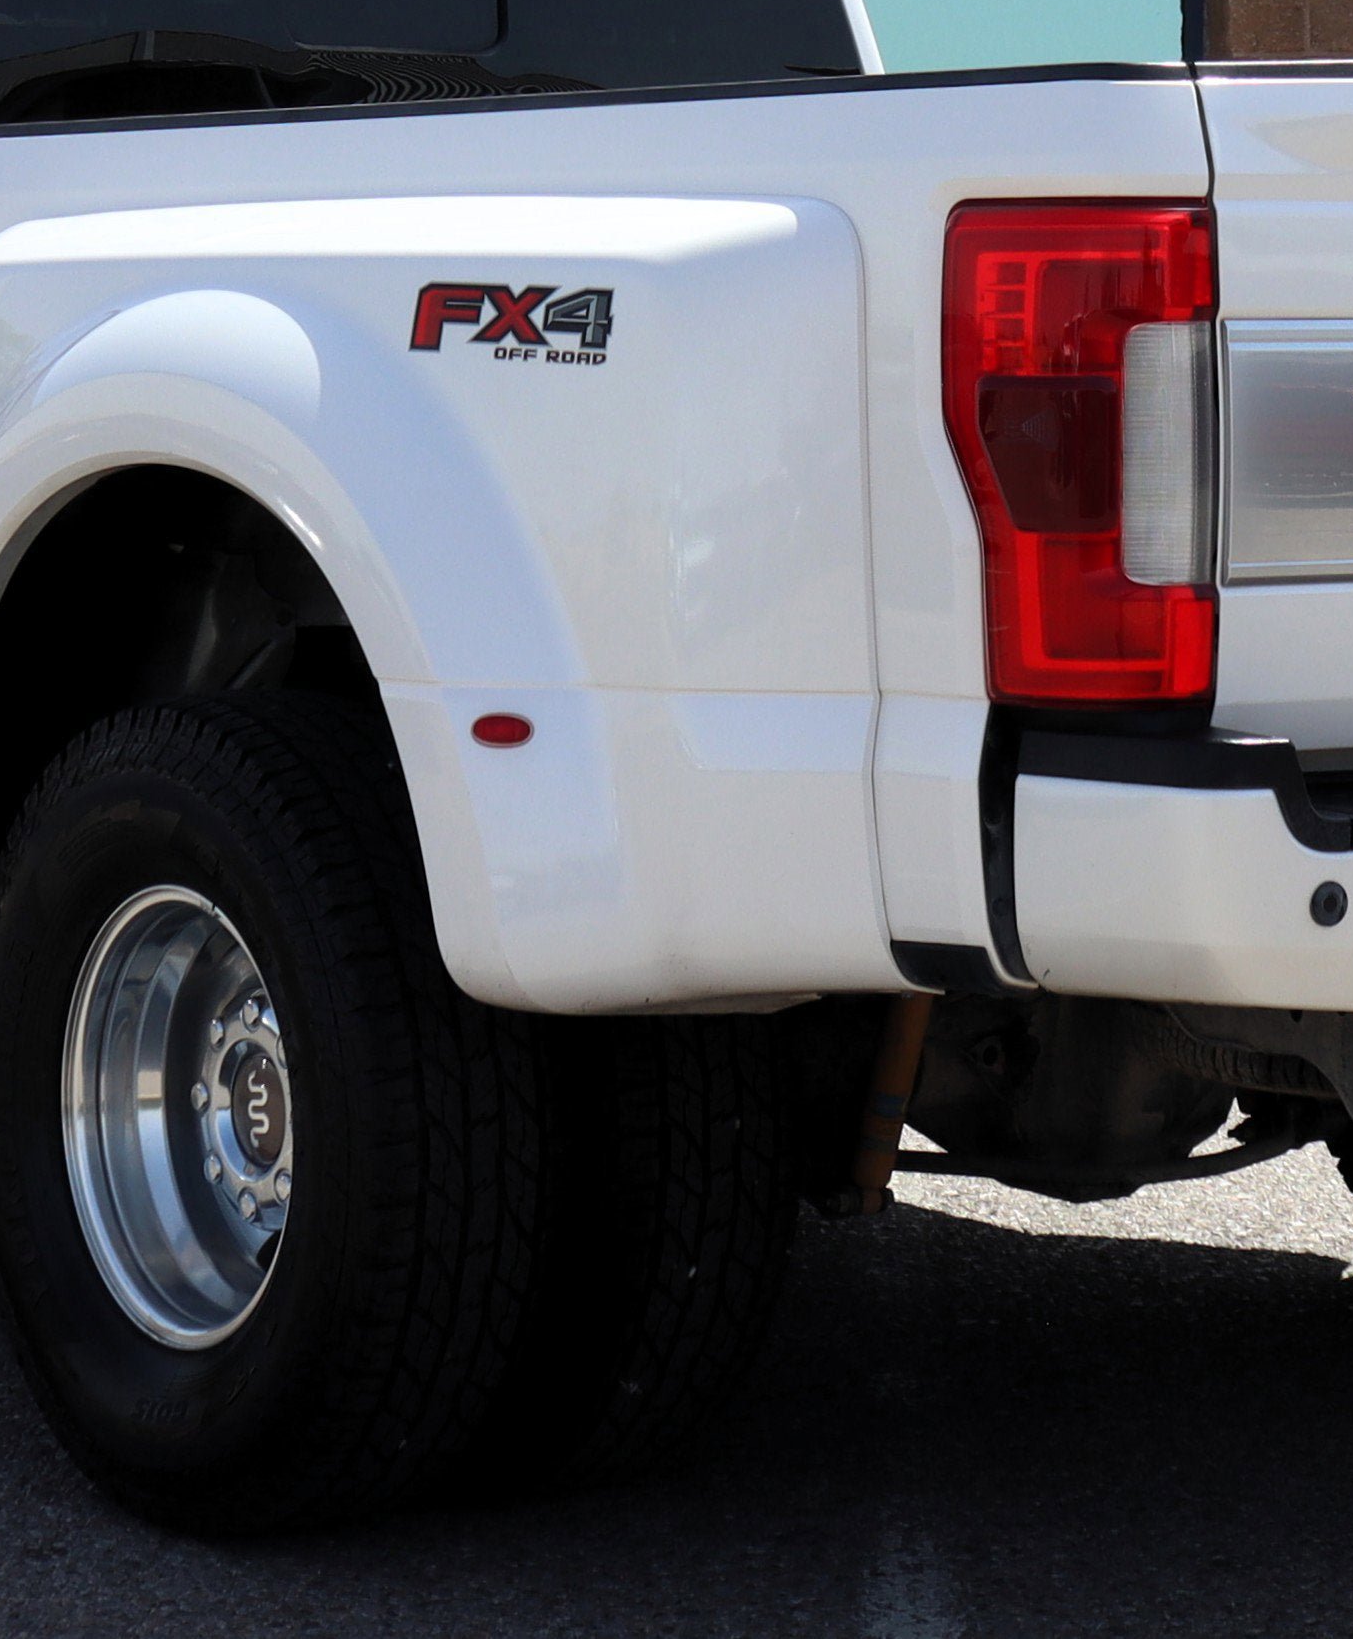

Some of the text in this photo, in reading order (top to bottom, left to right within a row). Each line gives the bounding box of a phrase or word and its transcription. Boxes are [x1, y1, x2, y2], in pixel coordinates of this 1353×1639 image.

[409, 281, 614, 351] FX4
[494, 346, 607, 366] OFF ROAD
